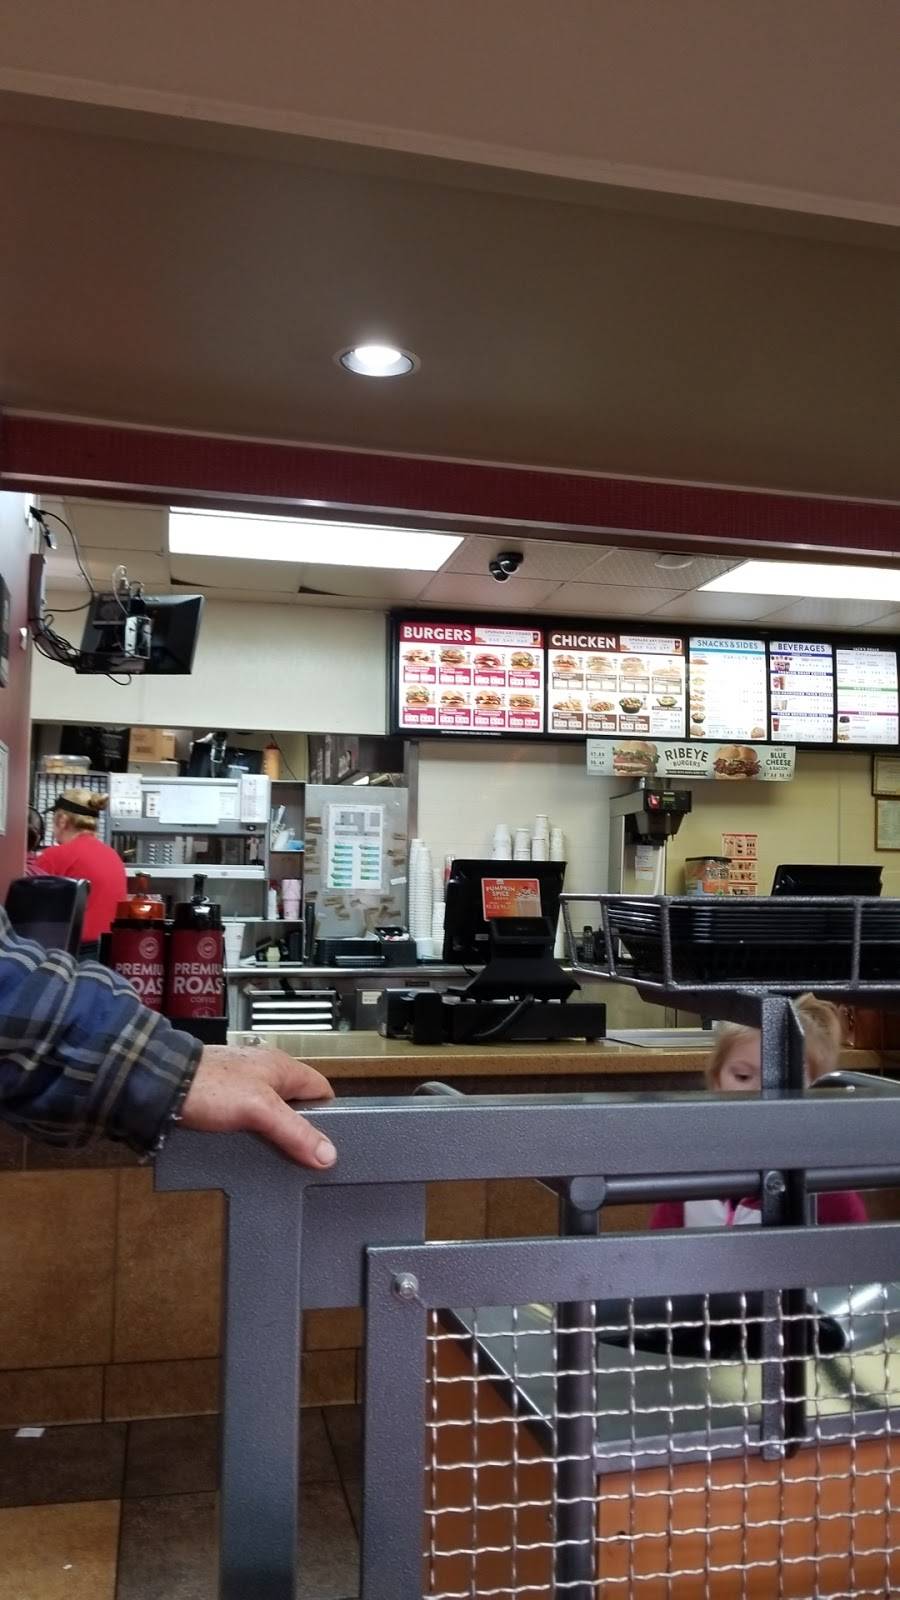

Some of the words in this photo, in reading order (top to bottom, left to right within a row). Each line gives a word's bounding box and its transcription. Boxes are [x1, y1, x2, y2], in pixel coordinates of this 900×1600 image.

[403, 625, 472, 641] BURGERS
[551, 634, 616, 649] CHICKEN
[777, 643, 826, 653] BEVERAGES
[664, 747, 709, 763] RIBEYE
[673, 759, 701, 768] BURGERS
[765, 759, 792, 767] CHEESE
[127, 976, 164, 995] OAS
